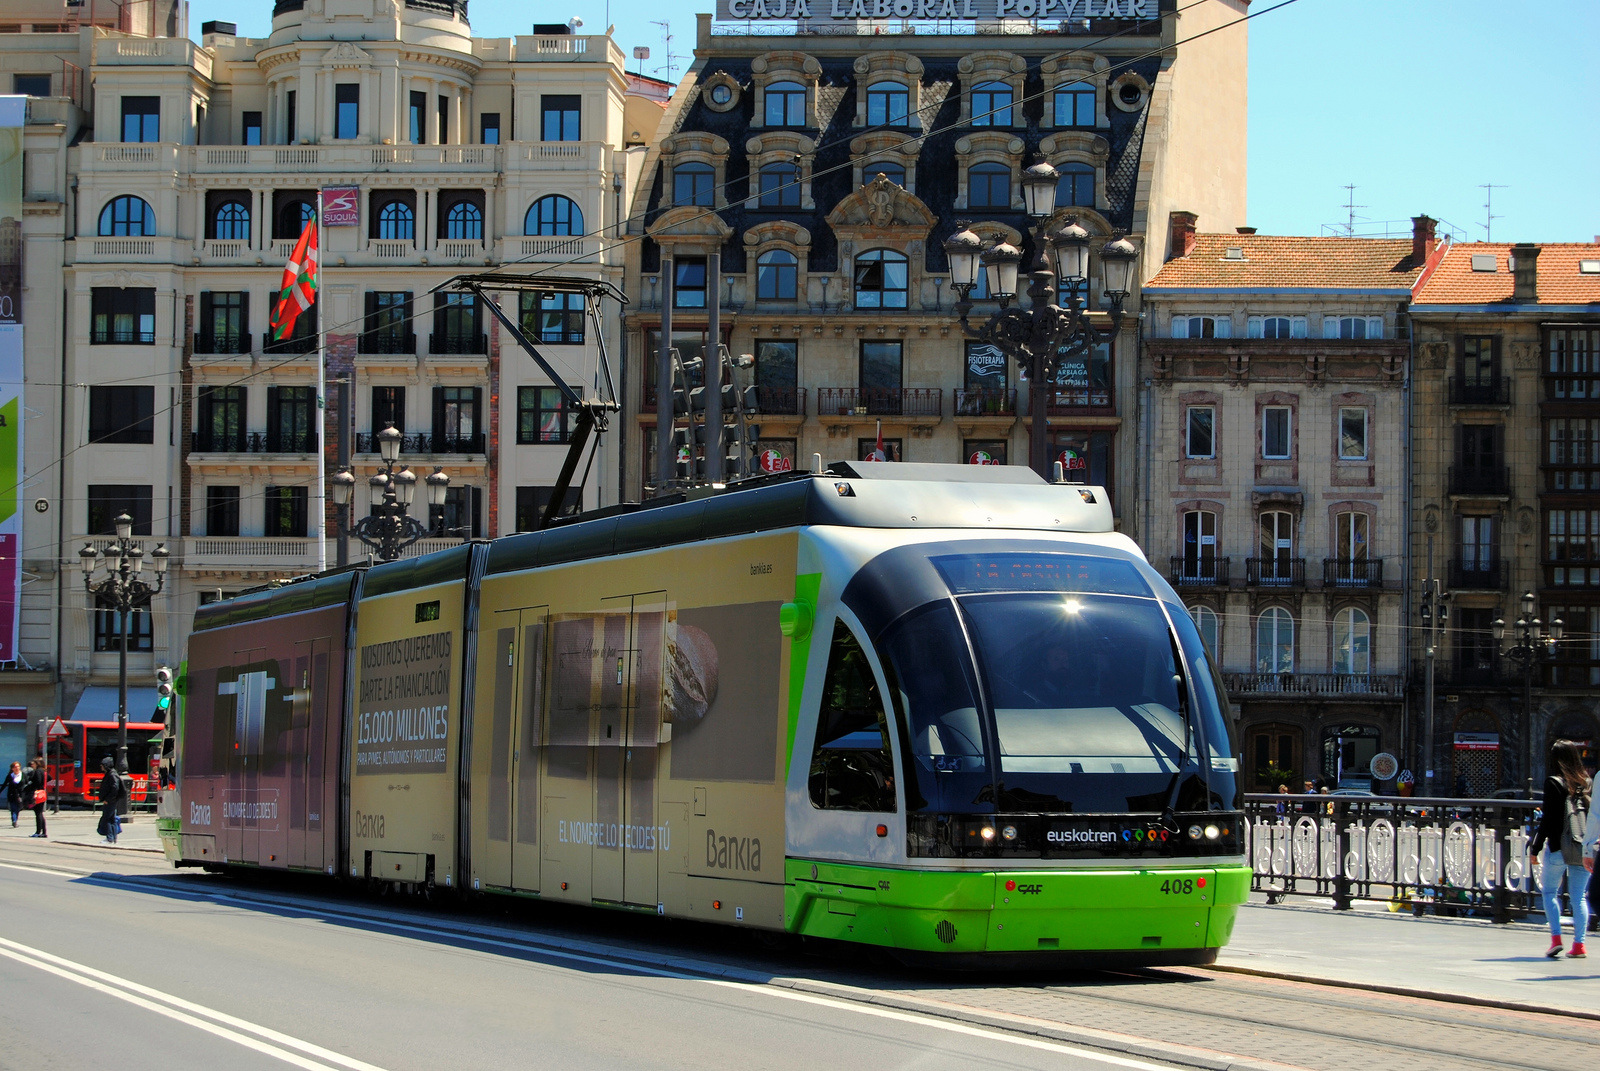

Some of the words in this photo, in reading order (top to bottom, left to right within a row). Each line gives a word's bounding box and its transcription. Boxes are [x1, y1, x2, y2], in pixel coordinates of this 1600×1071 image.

[728, 0, 811, 18] CAJA
[830, 0, 978, 18] LABORAL
[324, 213, 357, 222] SUQUIA
[968, 355, 1005, 365] FISIOTERAPIA
[1069, 457, 1086, 469] EA
[36, 502, 47, 510] 15
[361, 639, 402, 669] NOSOTROS
[404, 631, 451, 668] QUEREMOS
[360, 677, 383, 702] DARTE
[384, 675, 393, 701] LA
[395, 664, 449, 699] FINANCIACIÓN
[358, 709, 394, 744] 15.000
[396, 705, 448, 742] MILLONES
[190, 801, 211, 826] Bankia
[355, 810, 385, 839] Bankia
[559, 820, 568, 842] EL
[570, 821, 604, 846] NOMBRE
[606, 823, 617, 847] LO
[619, 824, 655, 850] DECIDES
[658, 820, 670, 851] TÚ
[1046, 829, 1117, 842] euskotren
[706, 829, 761, 872] Bankia
[1160, 879, 1193, 895] 408
